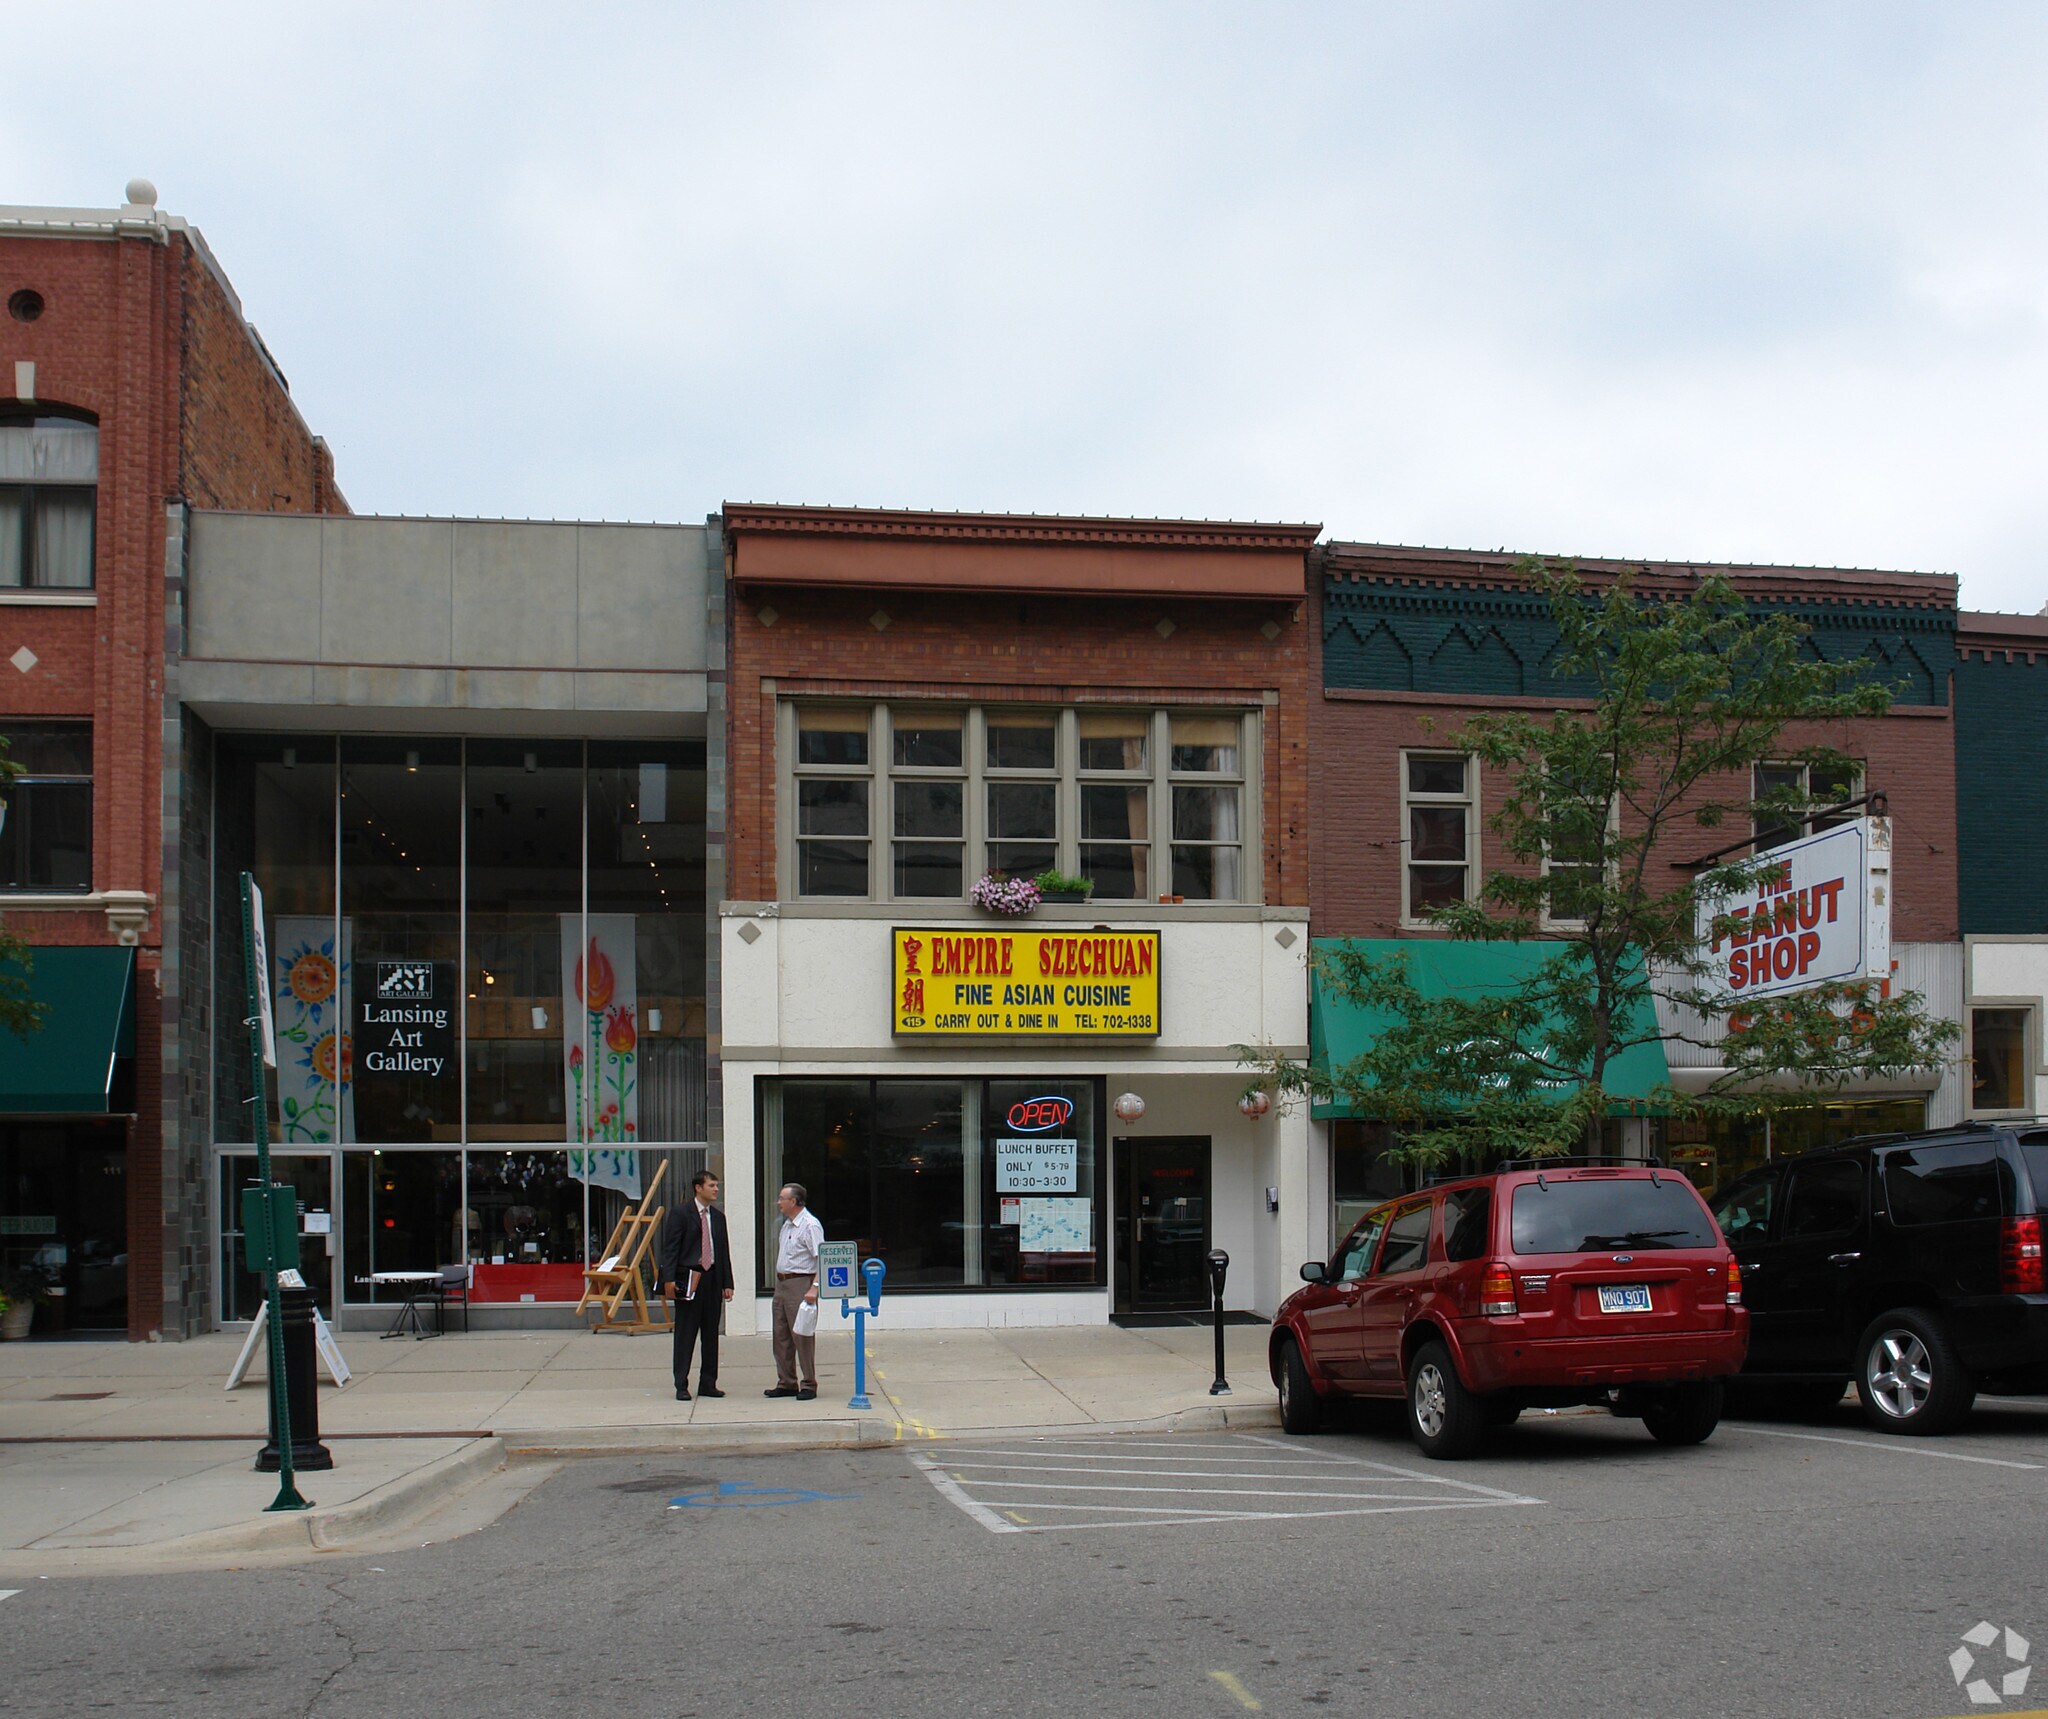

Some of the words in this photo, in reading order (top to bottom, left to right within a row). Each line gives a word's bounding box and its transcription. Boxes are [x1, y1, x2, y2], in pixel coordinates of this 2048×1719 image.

[1756, 858, 1793, 899] THE
[1711, 877, 1845, 955] PEANUT
[931, 936, 1014, 976] EMPIRE
[1039, 937, 1153, 977] SZECHUAN
[1728, 931, 1821, 990] SHOP
[954, 984, 993, 1005] FINE
[1003, 984, 1055, 1006] ASIAN
[1063, 984, 1131, 1007] CUISINE
[363, 1003, 448, 1029] Lansing
[905, 1017, 922, 1027] 115
[935, 1014, 971, 1028] CARRY
[977, 1014, 1000, 1028] OUT
[1005, 1014, 1013, 1028] &
[1018, 1014, 1042, 1028] DINE
[1048, 1014, 1058, 1028] IN
[1074, 1014, 1098, 1028] TEL:
[1102, 1015, 1152, 1028] 702-1338
[388, 1028, 423, 1047] Art
[365, 1051, 444, 1077] Gallery
[1008, 1102, 1069, 1126] OPEN
[998, 1144, 1033, 1155] LUNCH
[1035, 1144, 1075, 1155] BUFFET
[1006, 1161, 1034, 1172] ONLY
[820, 1247, 854, 1256] RESERVED
[823, 1257, 852, 1265] PARKING
[1625, 1290, 1646, 1306] 907
